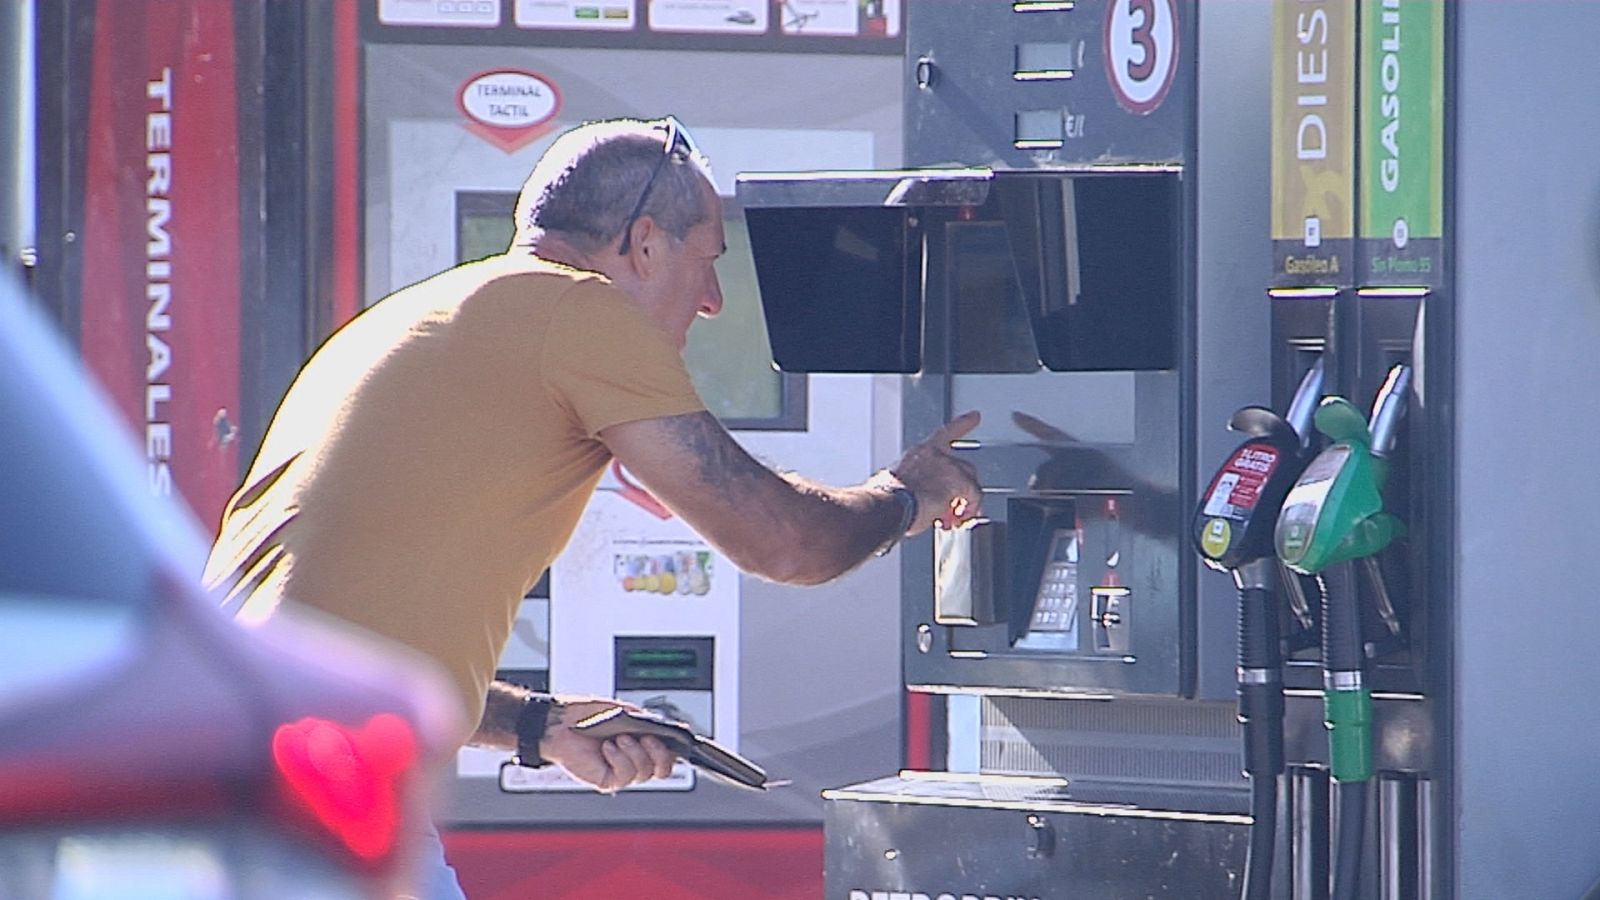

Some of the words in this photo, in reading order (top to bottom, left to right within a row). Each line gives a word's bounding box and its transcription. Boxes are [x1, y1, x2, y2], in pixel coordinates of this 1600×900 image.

[1127, 0, 1157, 82] 3
[478, 84, 541, 96] TERMINAL
[488, 104, 529, 118] TACTIL
[1297, 8, 1327, 160] DIES
[146, 67, 171, 498] TERMINALES
